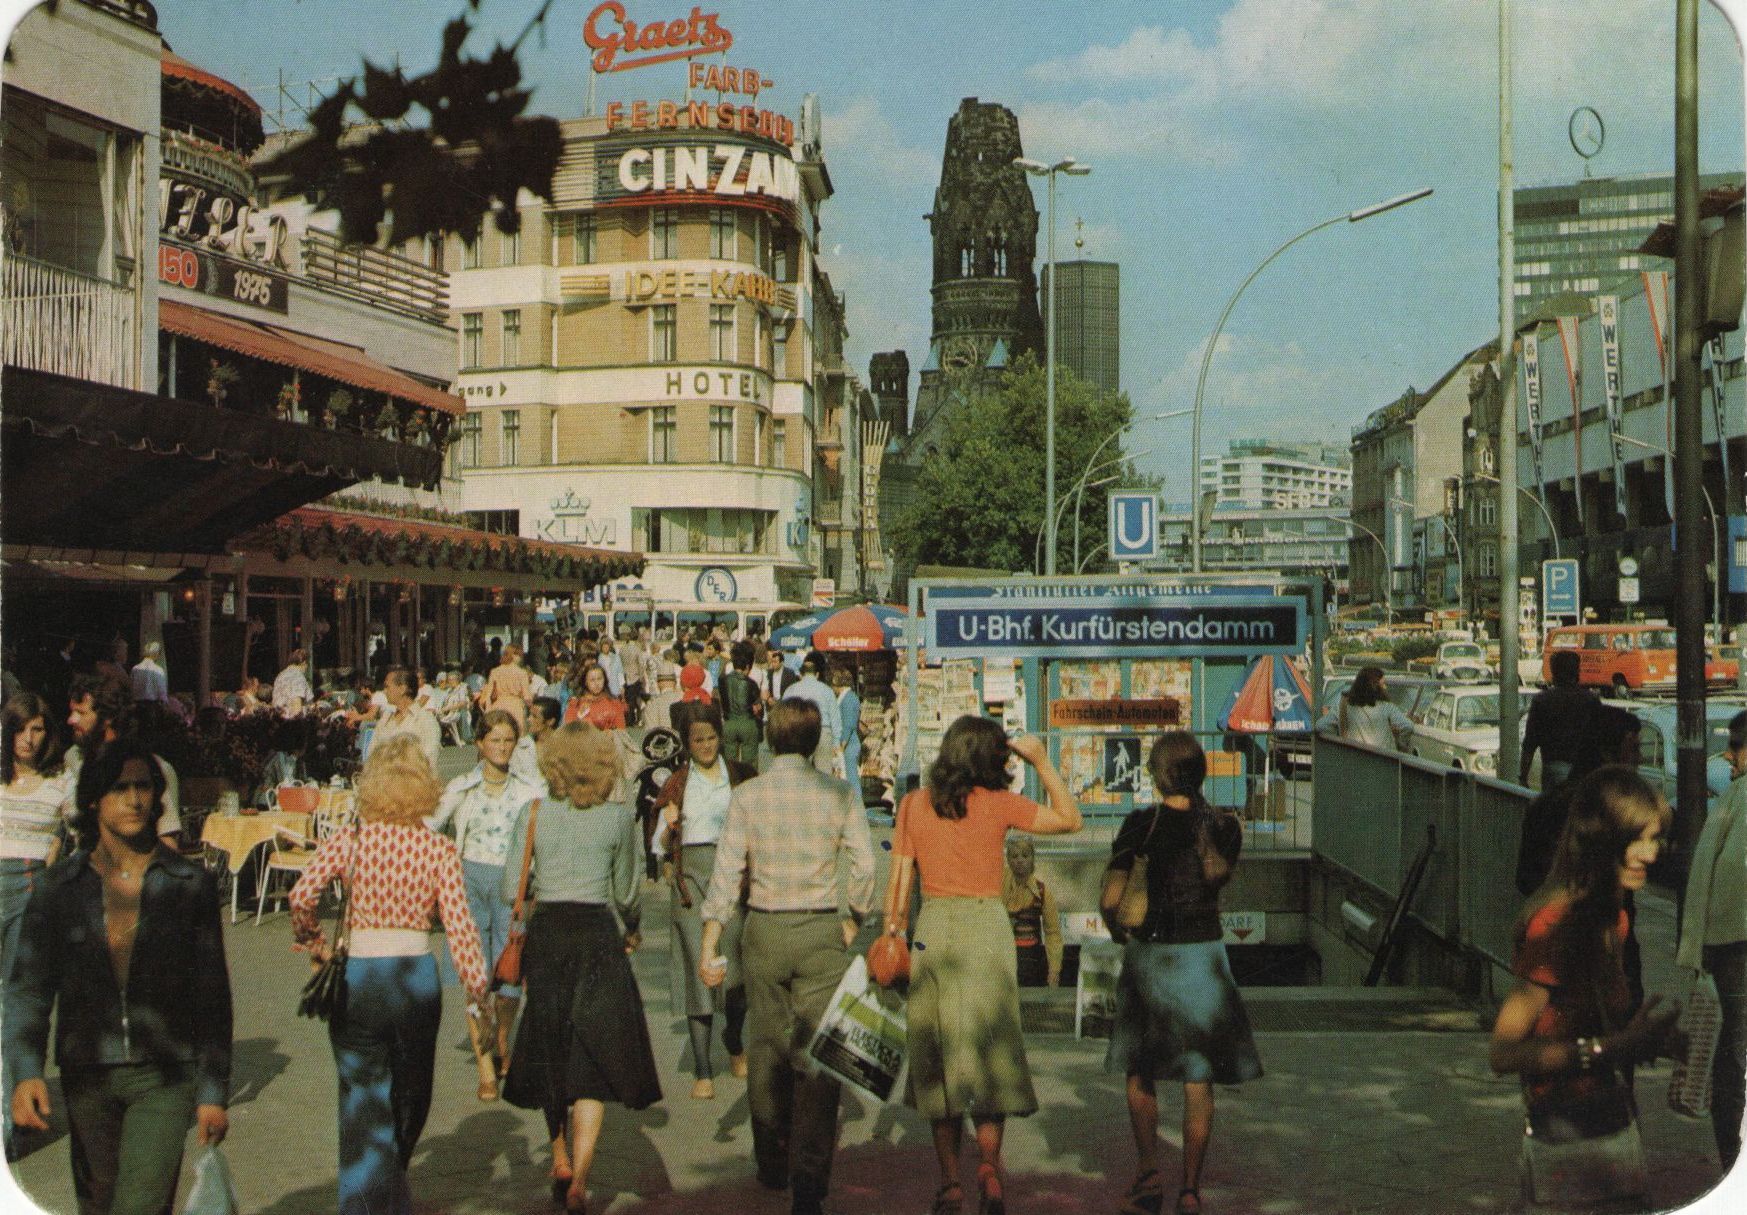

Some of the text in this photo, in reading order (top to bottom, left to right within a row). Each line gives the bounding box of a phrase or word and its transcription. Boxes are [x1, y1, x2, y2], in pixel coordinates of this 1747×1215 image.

[583, 1, 733, 72] Graetz
[690, 63, 774, 95] FARB-
[234, 270, 272, 305] 1975
[666, 371, 761, 399] HOTEL
[535, 518, 617, 545] KLM
[1117, 501, 1151, 550] U
[706, 574, 728, 602] DER
[1551, 567, 1568, 590] P
[958, 613, 1275, 640] U-Bhf. Kurfürstendamm
